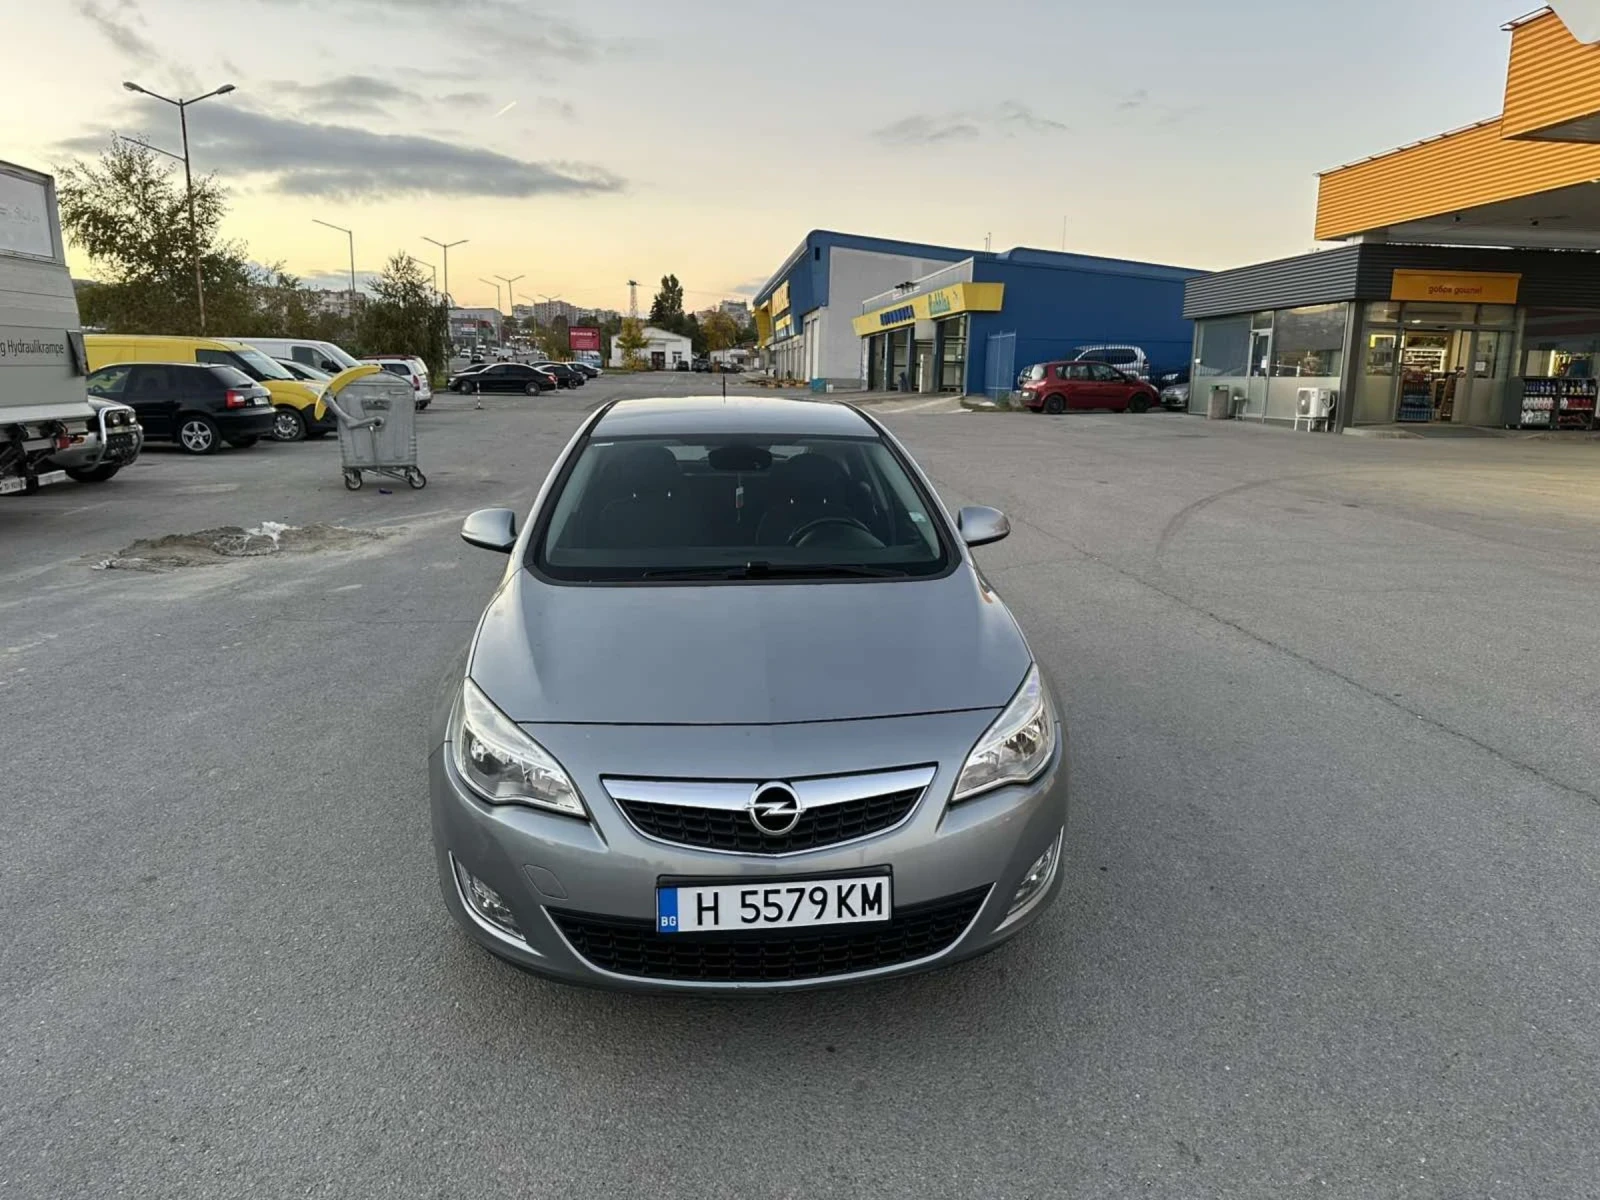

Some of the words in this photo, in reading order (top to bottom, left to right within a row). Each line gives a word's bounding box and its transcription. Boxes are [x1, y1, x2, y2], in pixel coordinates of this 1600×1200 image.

[7, 339, 64, 357] Hydraulikrampe
[697, 891, 719, 926] H
[661, 916, 676, 926] BG
